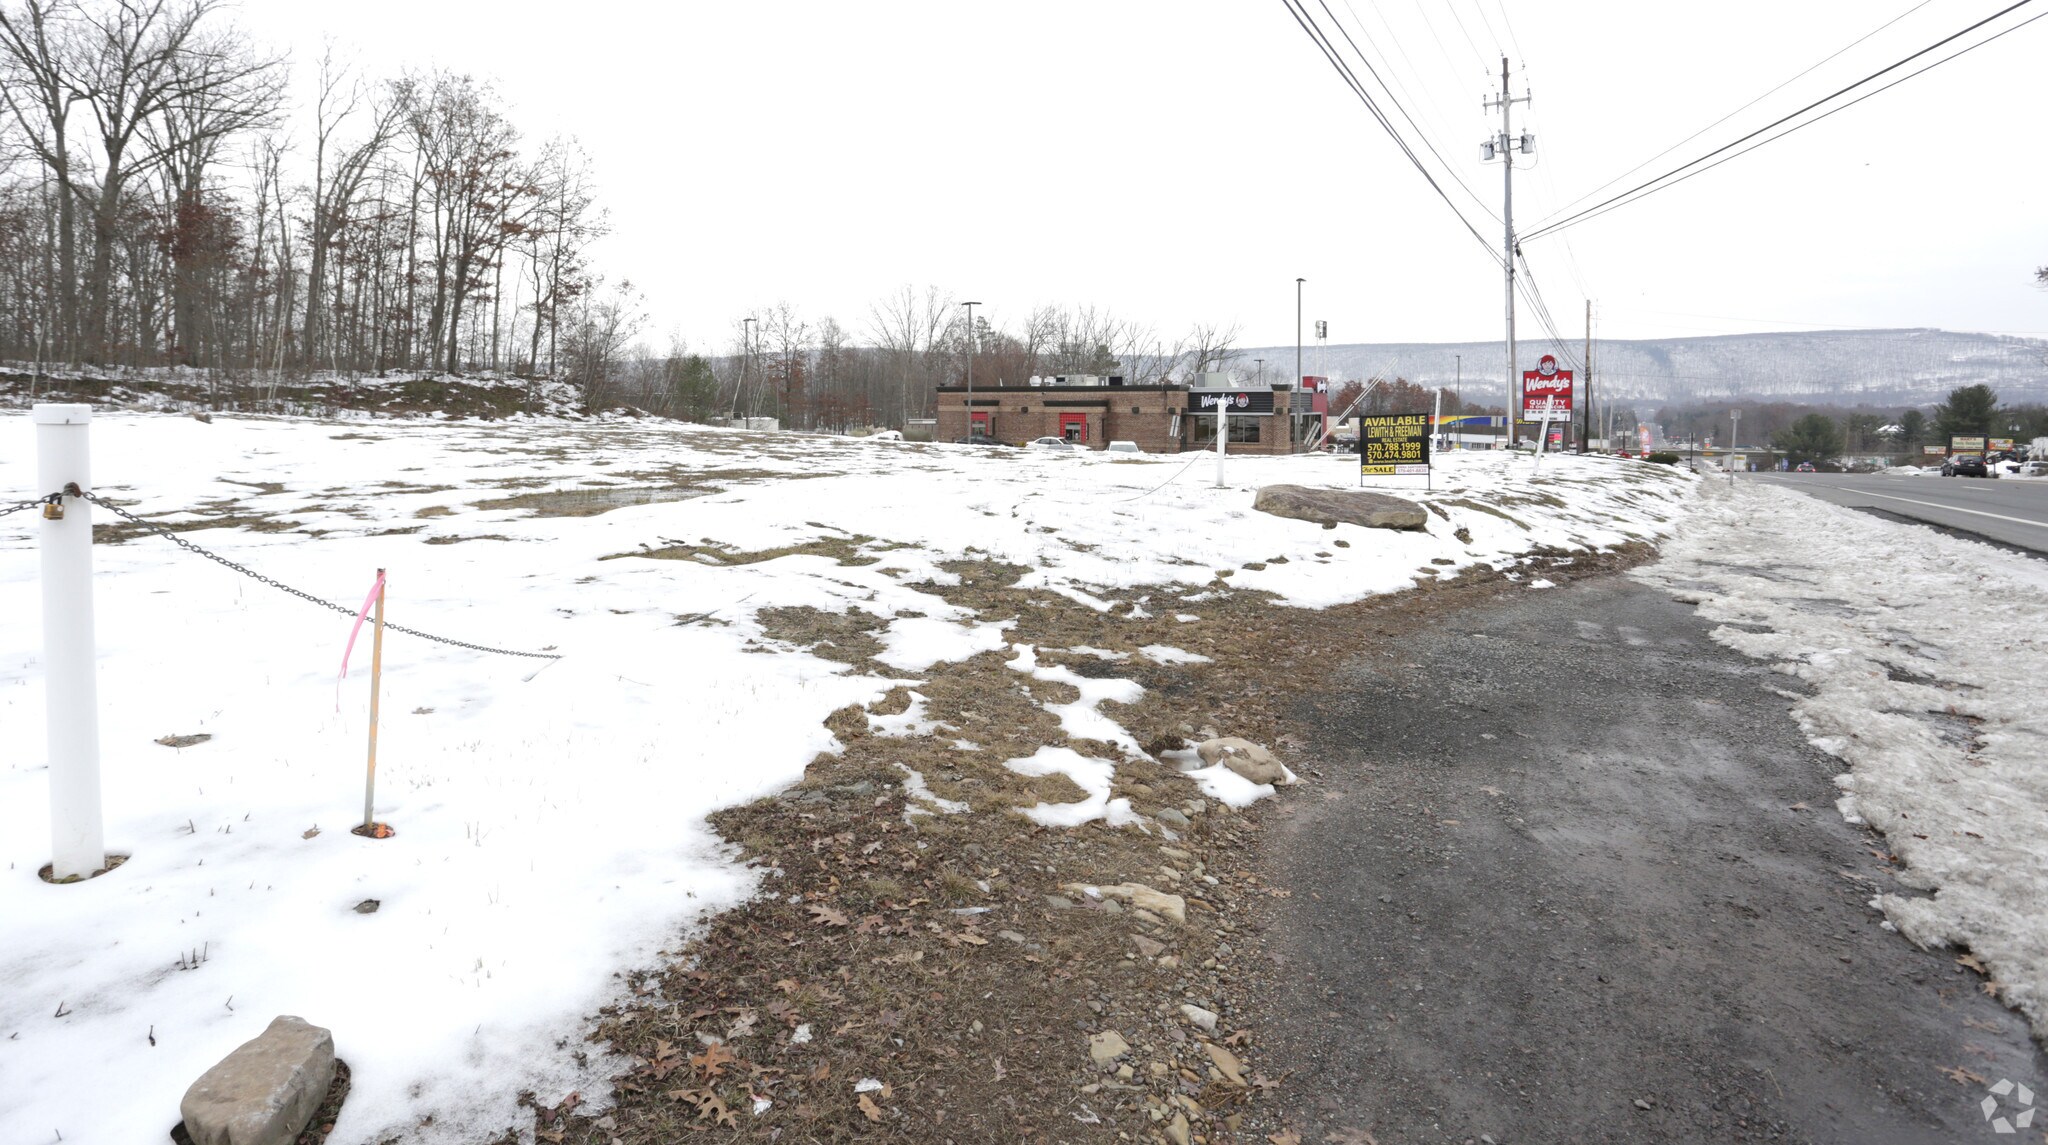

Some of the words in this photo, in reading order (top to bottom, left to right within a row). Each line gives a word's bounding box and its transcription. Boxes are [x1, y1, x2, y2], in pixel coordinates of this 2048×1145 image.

[1526, 375, 1570, 392] Wendy's
[1364, 416, 1425, 427] AVAILABLE
[1367, 426, 1389, 438] LEWITH
[1389, 426, 1395, 438] &
[1395, 425, 1422, 437] FREEMAN
[1367, 442, 1421, 451] 570.788.1999
[1367, 450, 1421, 459] 570.474.9801
